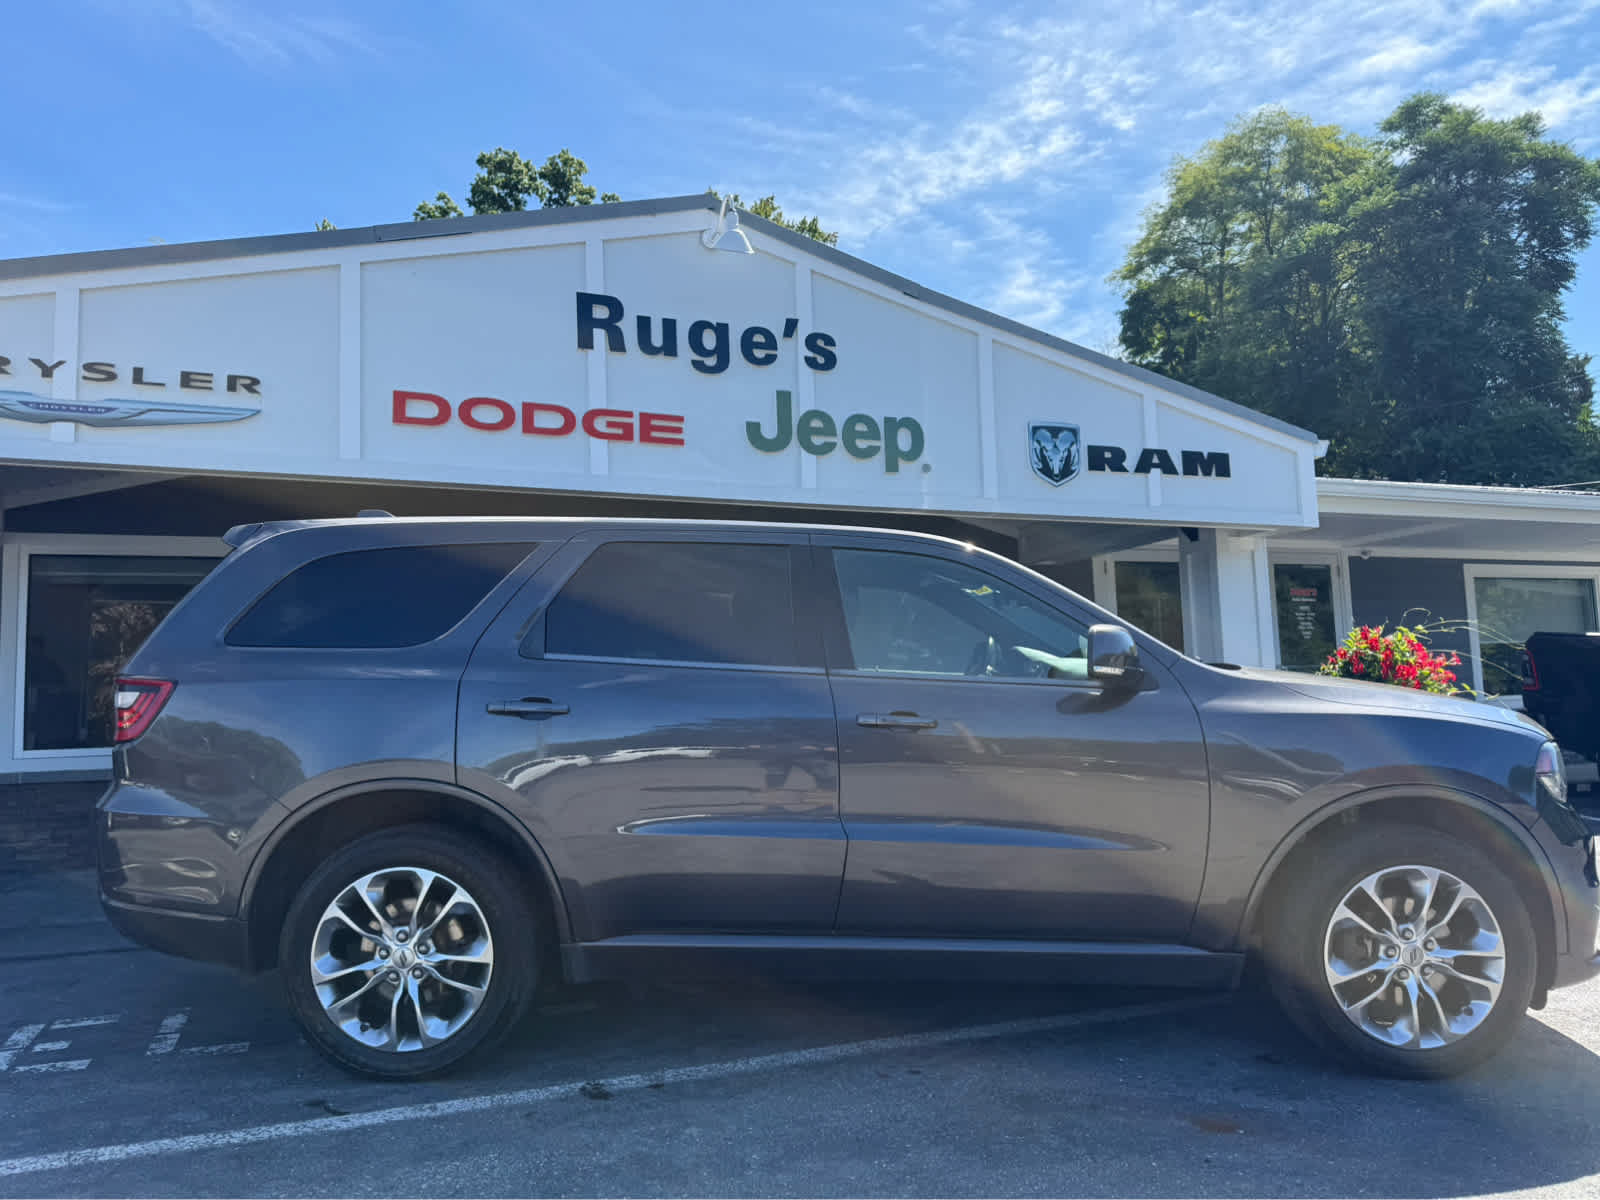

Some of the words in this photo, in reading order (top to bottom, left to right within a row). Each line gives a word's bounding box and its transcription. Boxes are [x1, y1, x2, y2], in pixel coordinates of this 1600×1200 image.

[576, 291, 838, 374] Ruge's
[392, 390, 685, 446] DODGE
[745, 390, 926, 473] Jeep
[1087, 445, 1231, 478] RAM
